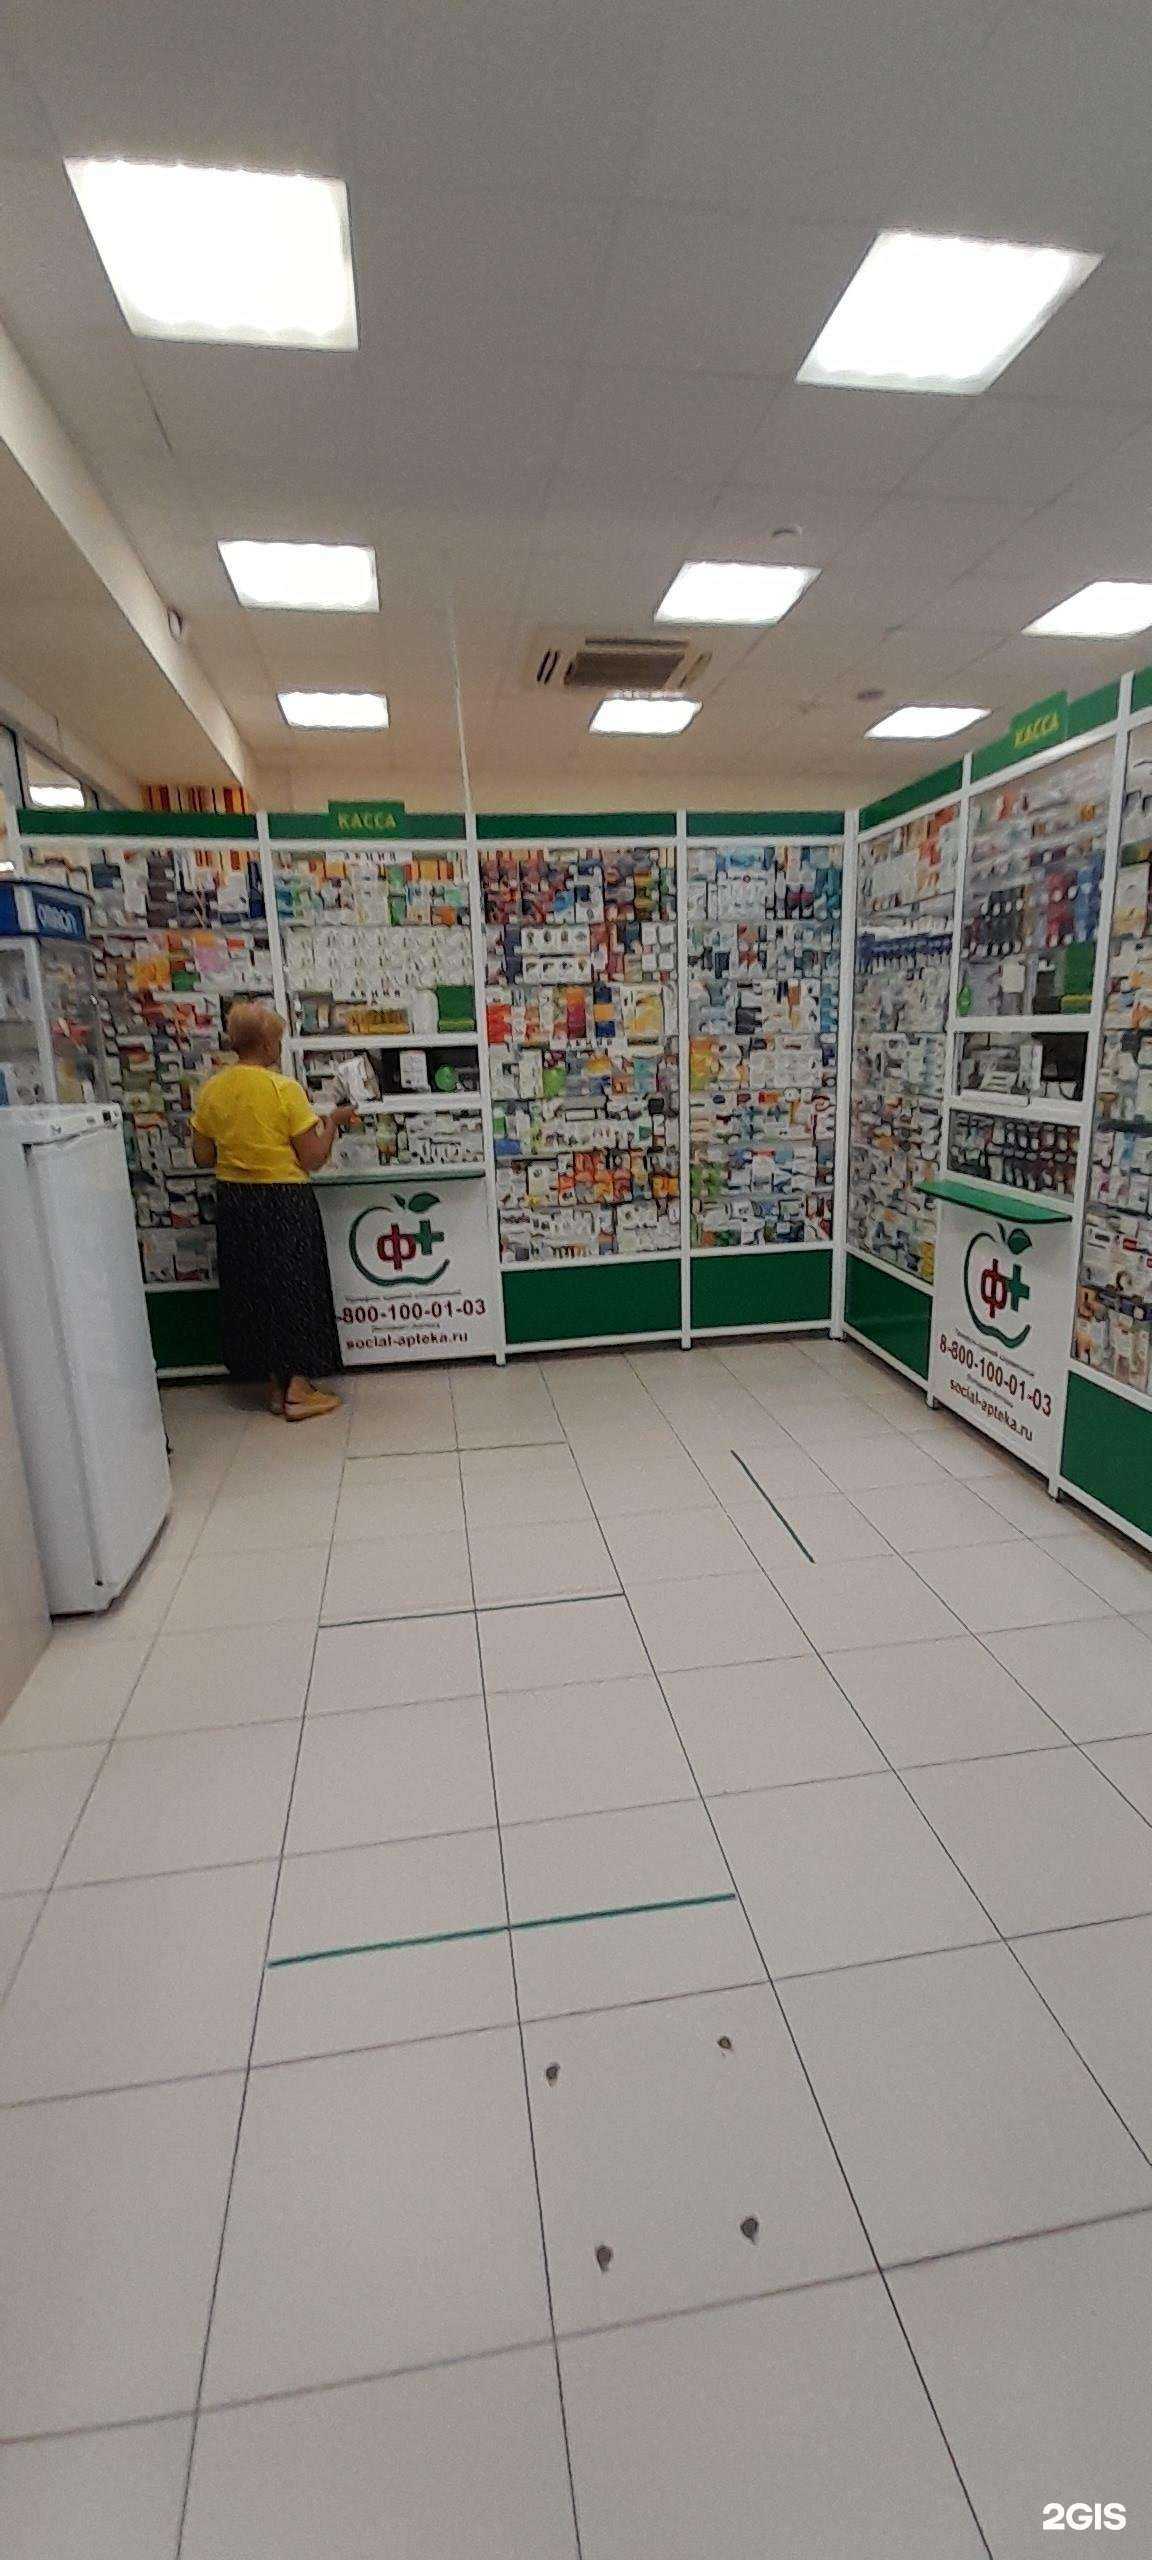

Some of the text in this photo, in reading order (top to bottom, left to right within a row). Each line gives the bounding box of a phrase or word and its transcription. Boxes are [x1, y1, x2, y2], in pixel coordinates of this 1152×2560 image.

[1013, 712, 1060, 750] КАССА
[338, 812, 397, 831] КАССА
[336, 1298, 487, 1324] -800-100-01-03
[345, 1331, 469, 1350] social-apteka.ru
[939, 1333, 1052, 1417] 8-800-100-01-03
[950, 1379, 1033, 1441] social-apteka.ru
